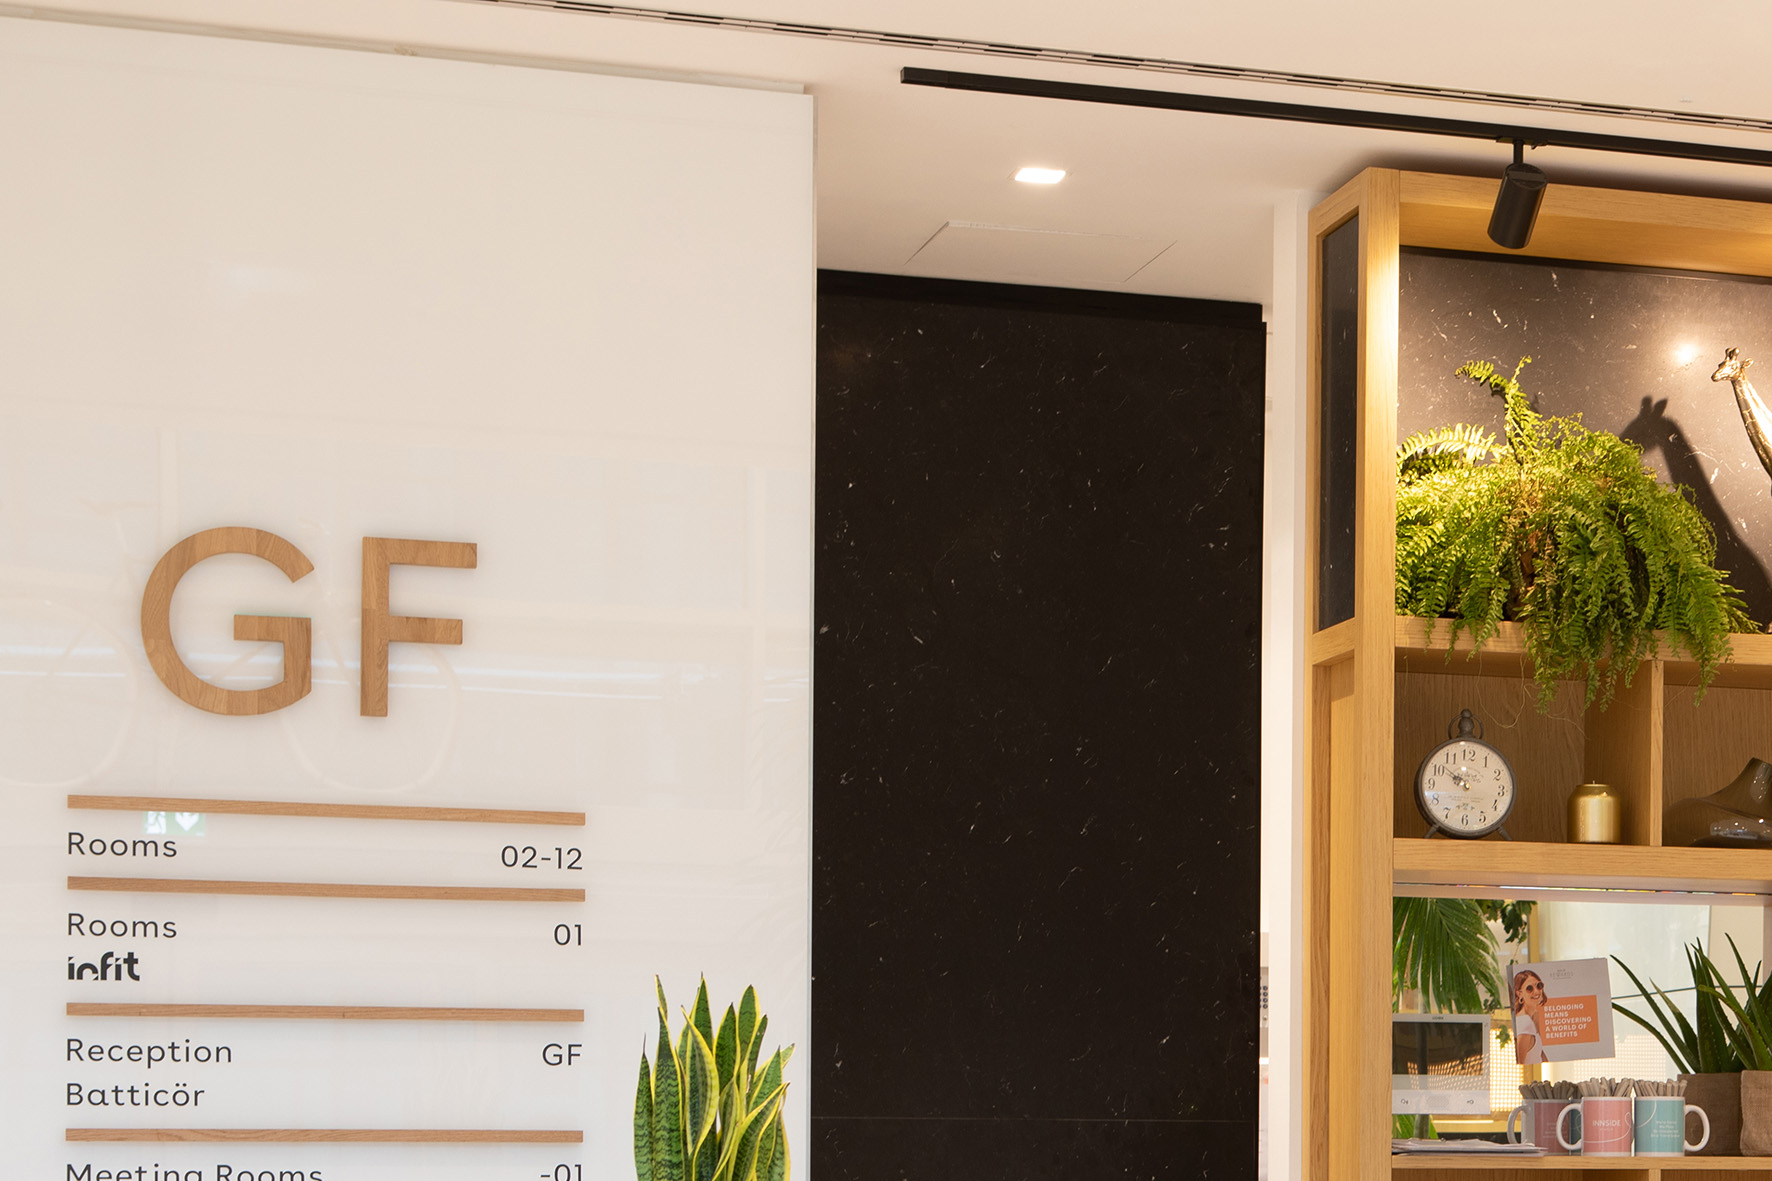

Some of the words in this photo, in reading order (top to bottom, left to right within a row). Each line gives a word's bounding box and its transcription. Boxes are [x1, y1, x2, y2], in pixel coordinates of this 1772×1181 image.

[140, 526, 478, 718] GF
[1445, 751, 1457, 765] 11
[1462, 748, 1476, 762] 12
[1483, 755, 1488, 768] 1
[1433, 764, 1445, 777] 10
[1493, 769, 1501, 781] 2
[1428, 778, 1436, 790] 9
[1497, 785, 1505, 797] 3
[1431, 793, 1440, 806] 8
[1491, 799, 1498, 812] 4
[1443, 807, 1451, 819] 7
[1461, 813, 1469, 826] 6
[1479, 811, 1487, 824] 5
[68, 832, 178, 858] Rooms
[501, 845, 583, 871] 02-12
[68, 912, 177, 939] Rooms
[553, 923, 582, 946] 01
[67, 951, 141, 982] infit
[1543, 1003, 1584, 1012] BELONGING
[1544, 1011, 1569, 1019] MEANS
[1544, 1016, 1592, 1026] DISCOVERING
[1545, 1031, 1578, 1039] BENEFITS
[66, 1038, 232, 1069] Reception
[542, 1043, 583, 1067] GF
[66, 1082, 205, 1107] Batticör
